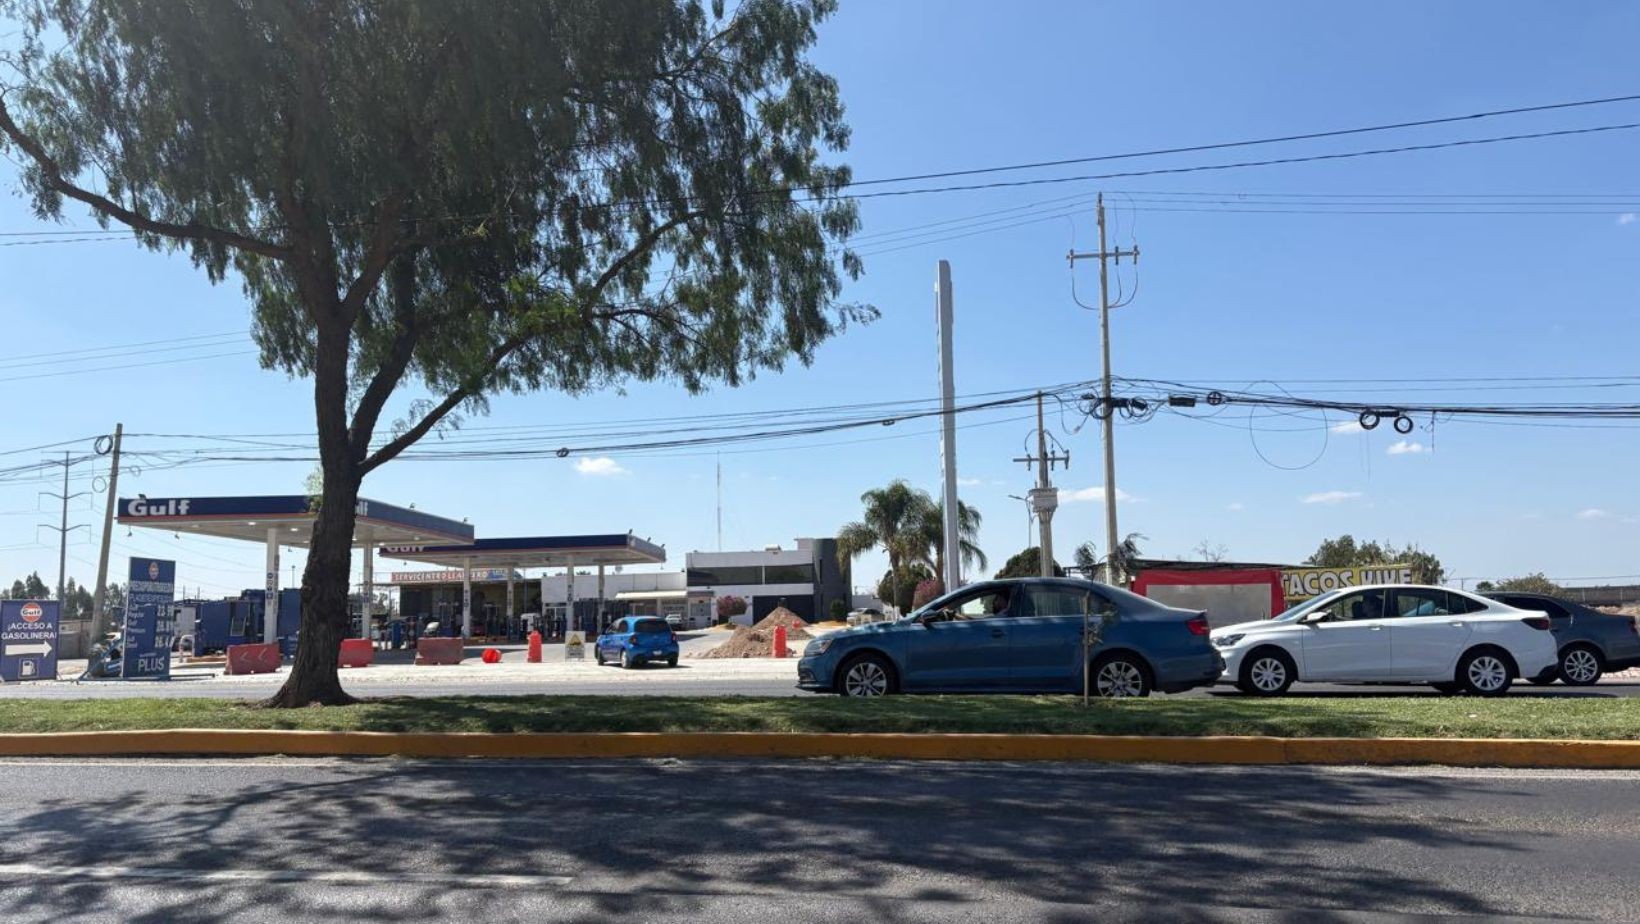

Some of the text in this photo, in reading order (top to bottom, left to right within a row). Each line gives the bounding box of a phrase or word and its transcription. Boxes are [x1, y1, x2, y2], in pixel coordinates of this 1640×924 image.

[128, 499, 190, 517] Gulf
[22, 608, 41, 616] Gulf
[8, 622, 45, 631] ¡ACCESO
[138, 656, 165, 672] PLUS
